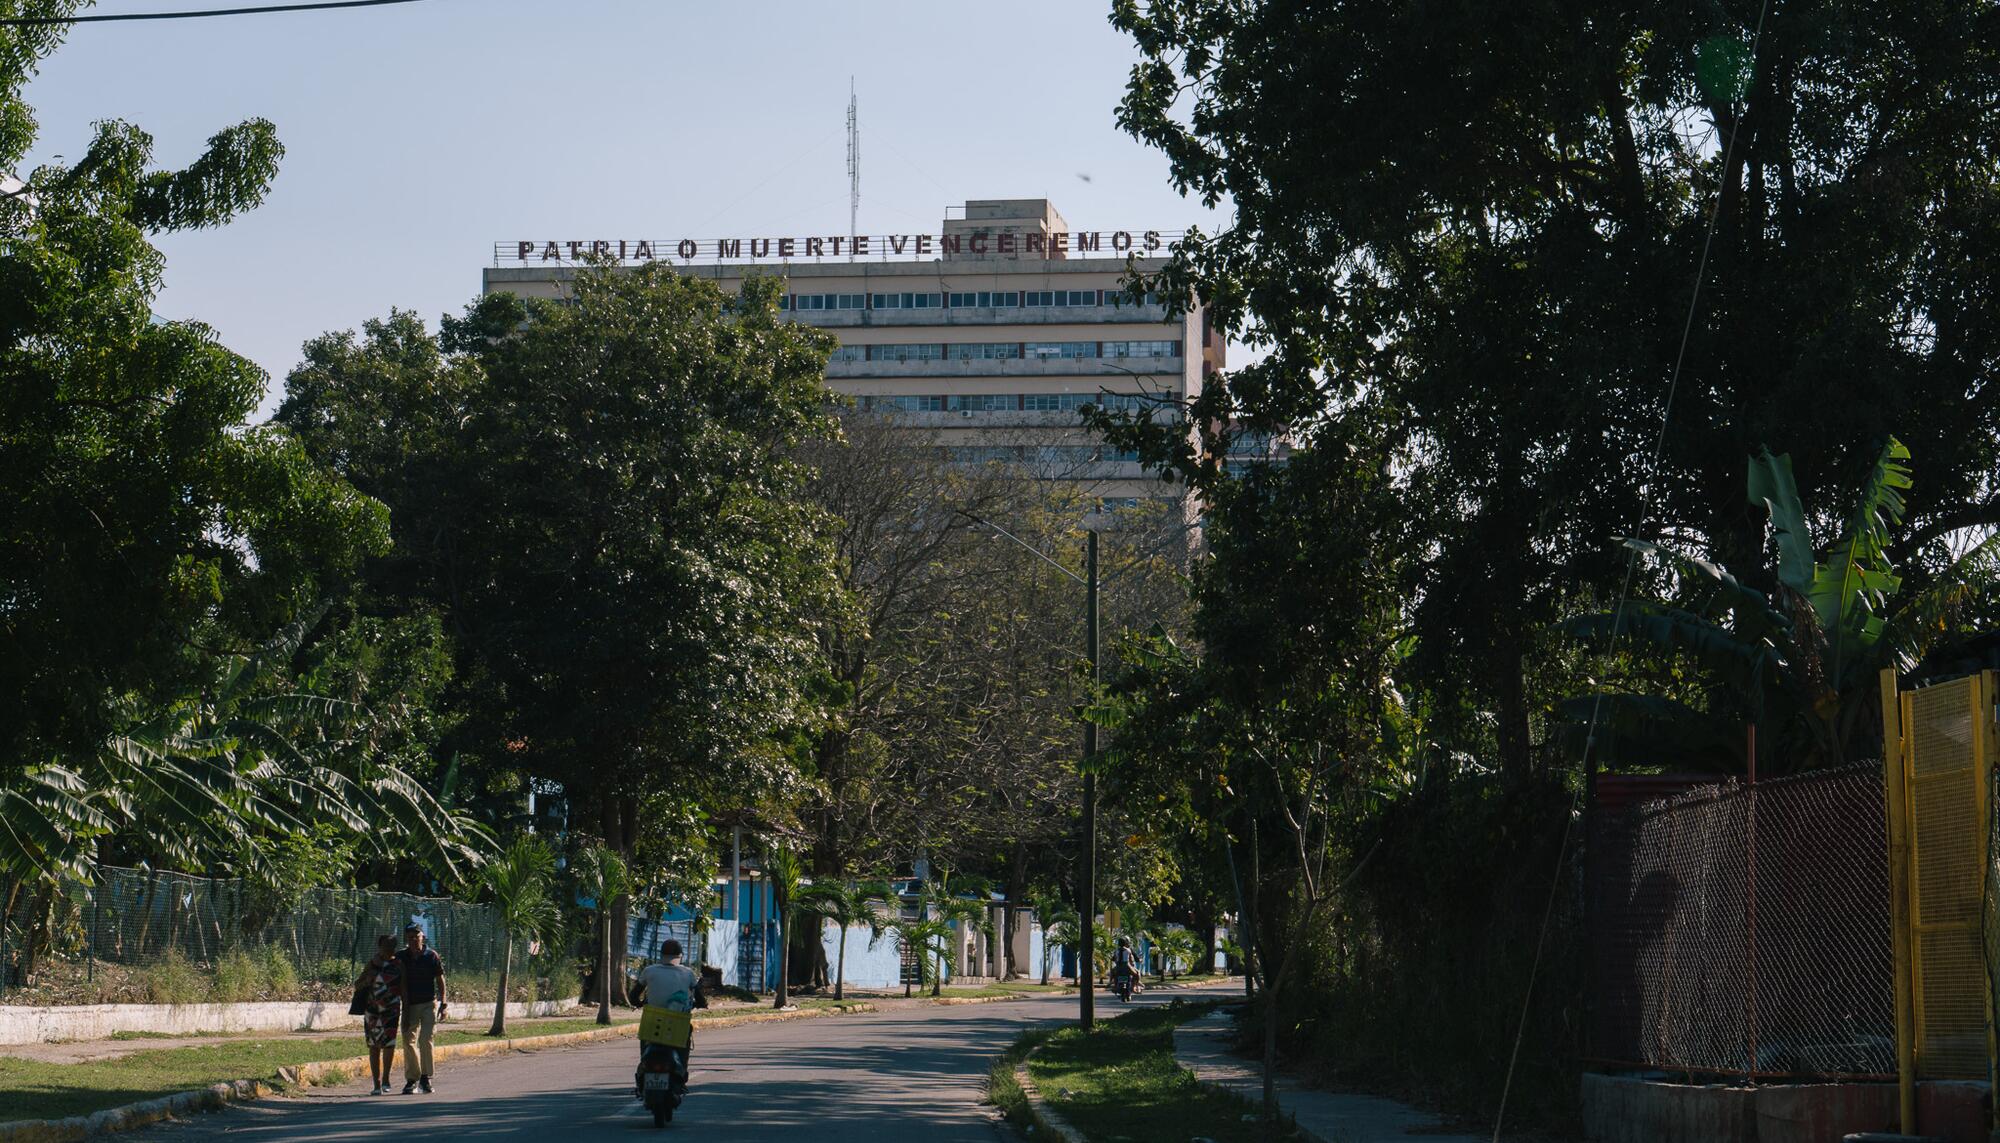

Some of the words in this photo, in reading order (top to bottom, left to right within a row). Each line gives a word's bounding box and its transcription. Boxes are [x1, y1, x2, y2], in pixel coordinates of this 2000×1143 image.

[518, 240, 654, 260] PATRIA
[678, 238, 698, 259] O
[719, 236, 869, 258] MUERTE
[888, 231, 1162, 255] VENCEREMOS
